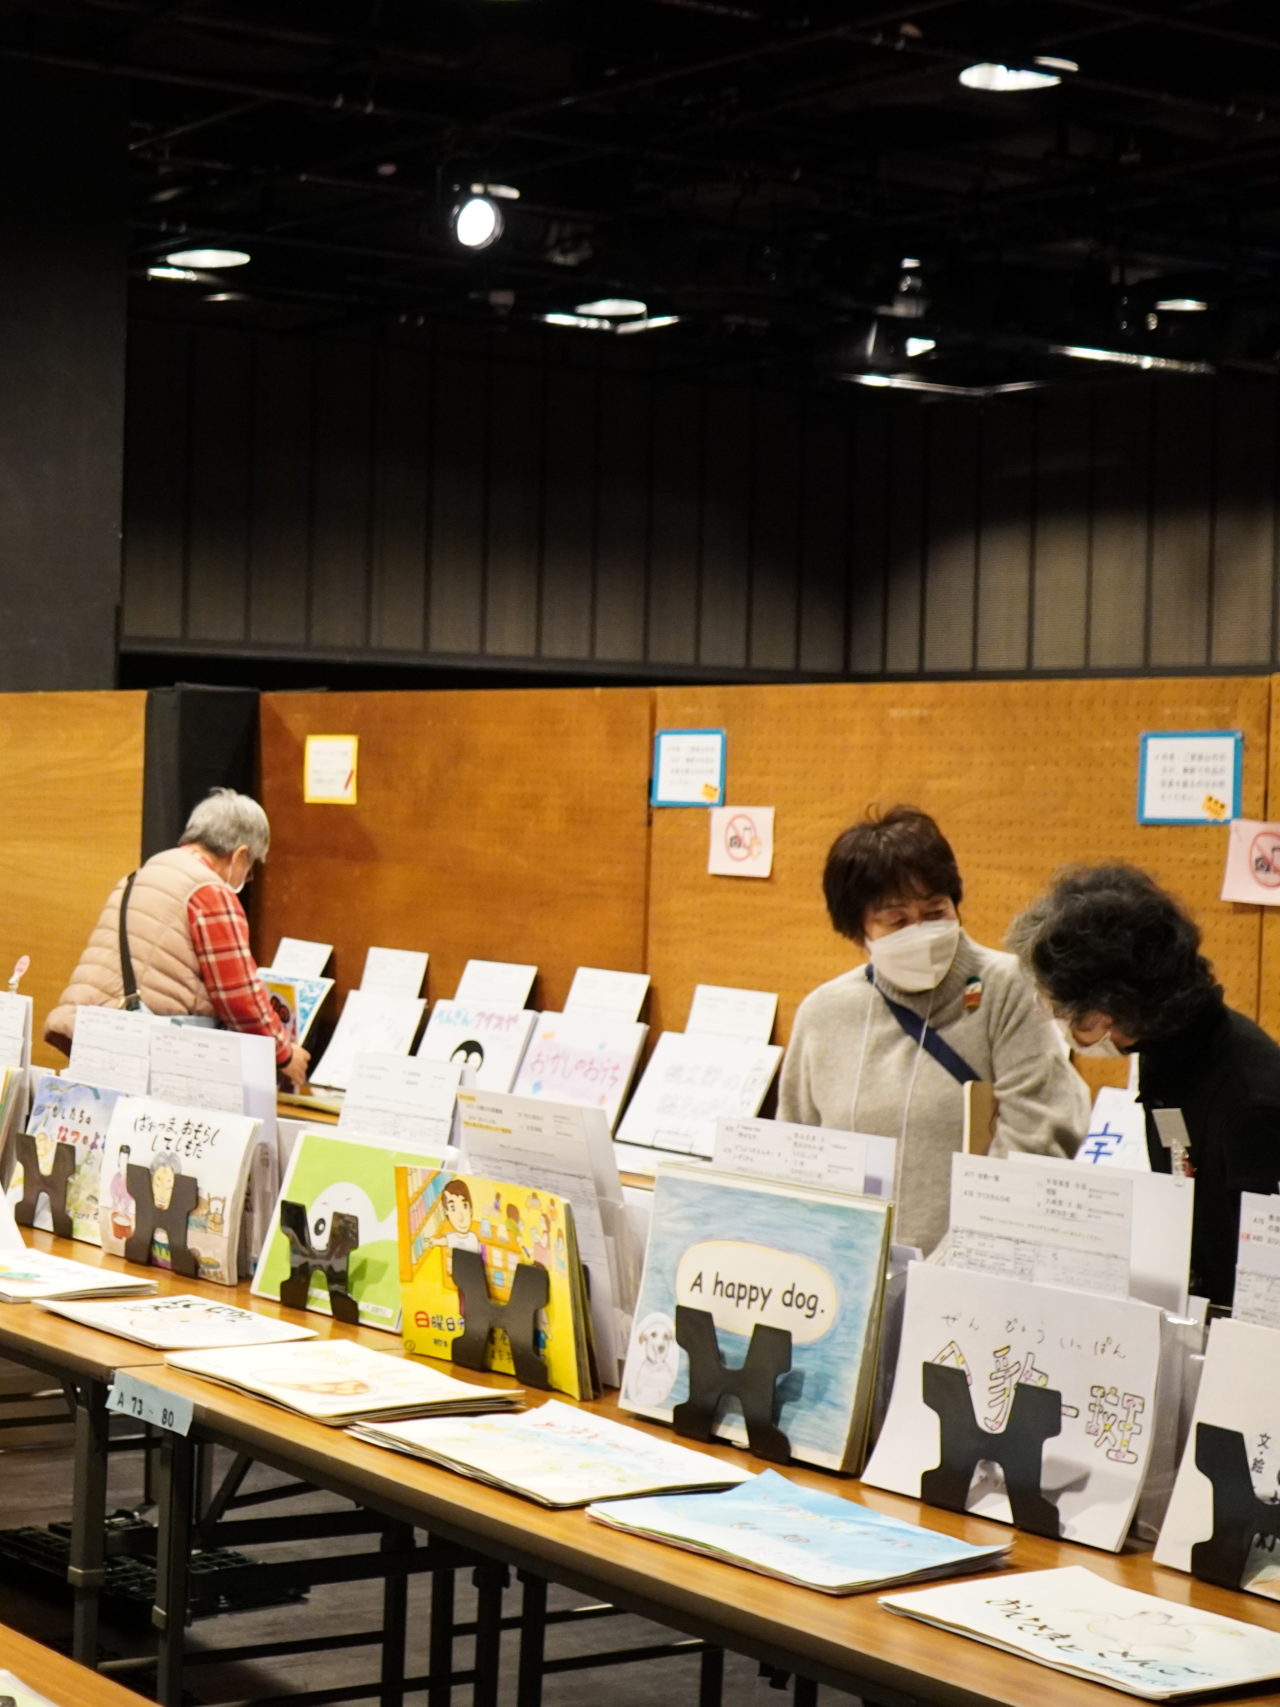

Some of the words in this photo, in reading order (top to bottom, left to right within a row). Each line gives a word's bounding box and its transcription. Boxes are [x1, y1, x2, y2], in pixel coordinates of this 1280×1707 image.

[689, 1271, 704, 1294] A
[712, 1271, 773, 1312] happy
[781, 1282, 825, 1319] dog.
[131, 1396, 144, 1416] 73
[161, 1407, 175, 1428] 80
